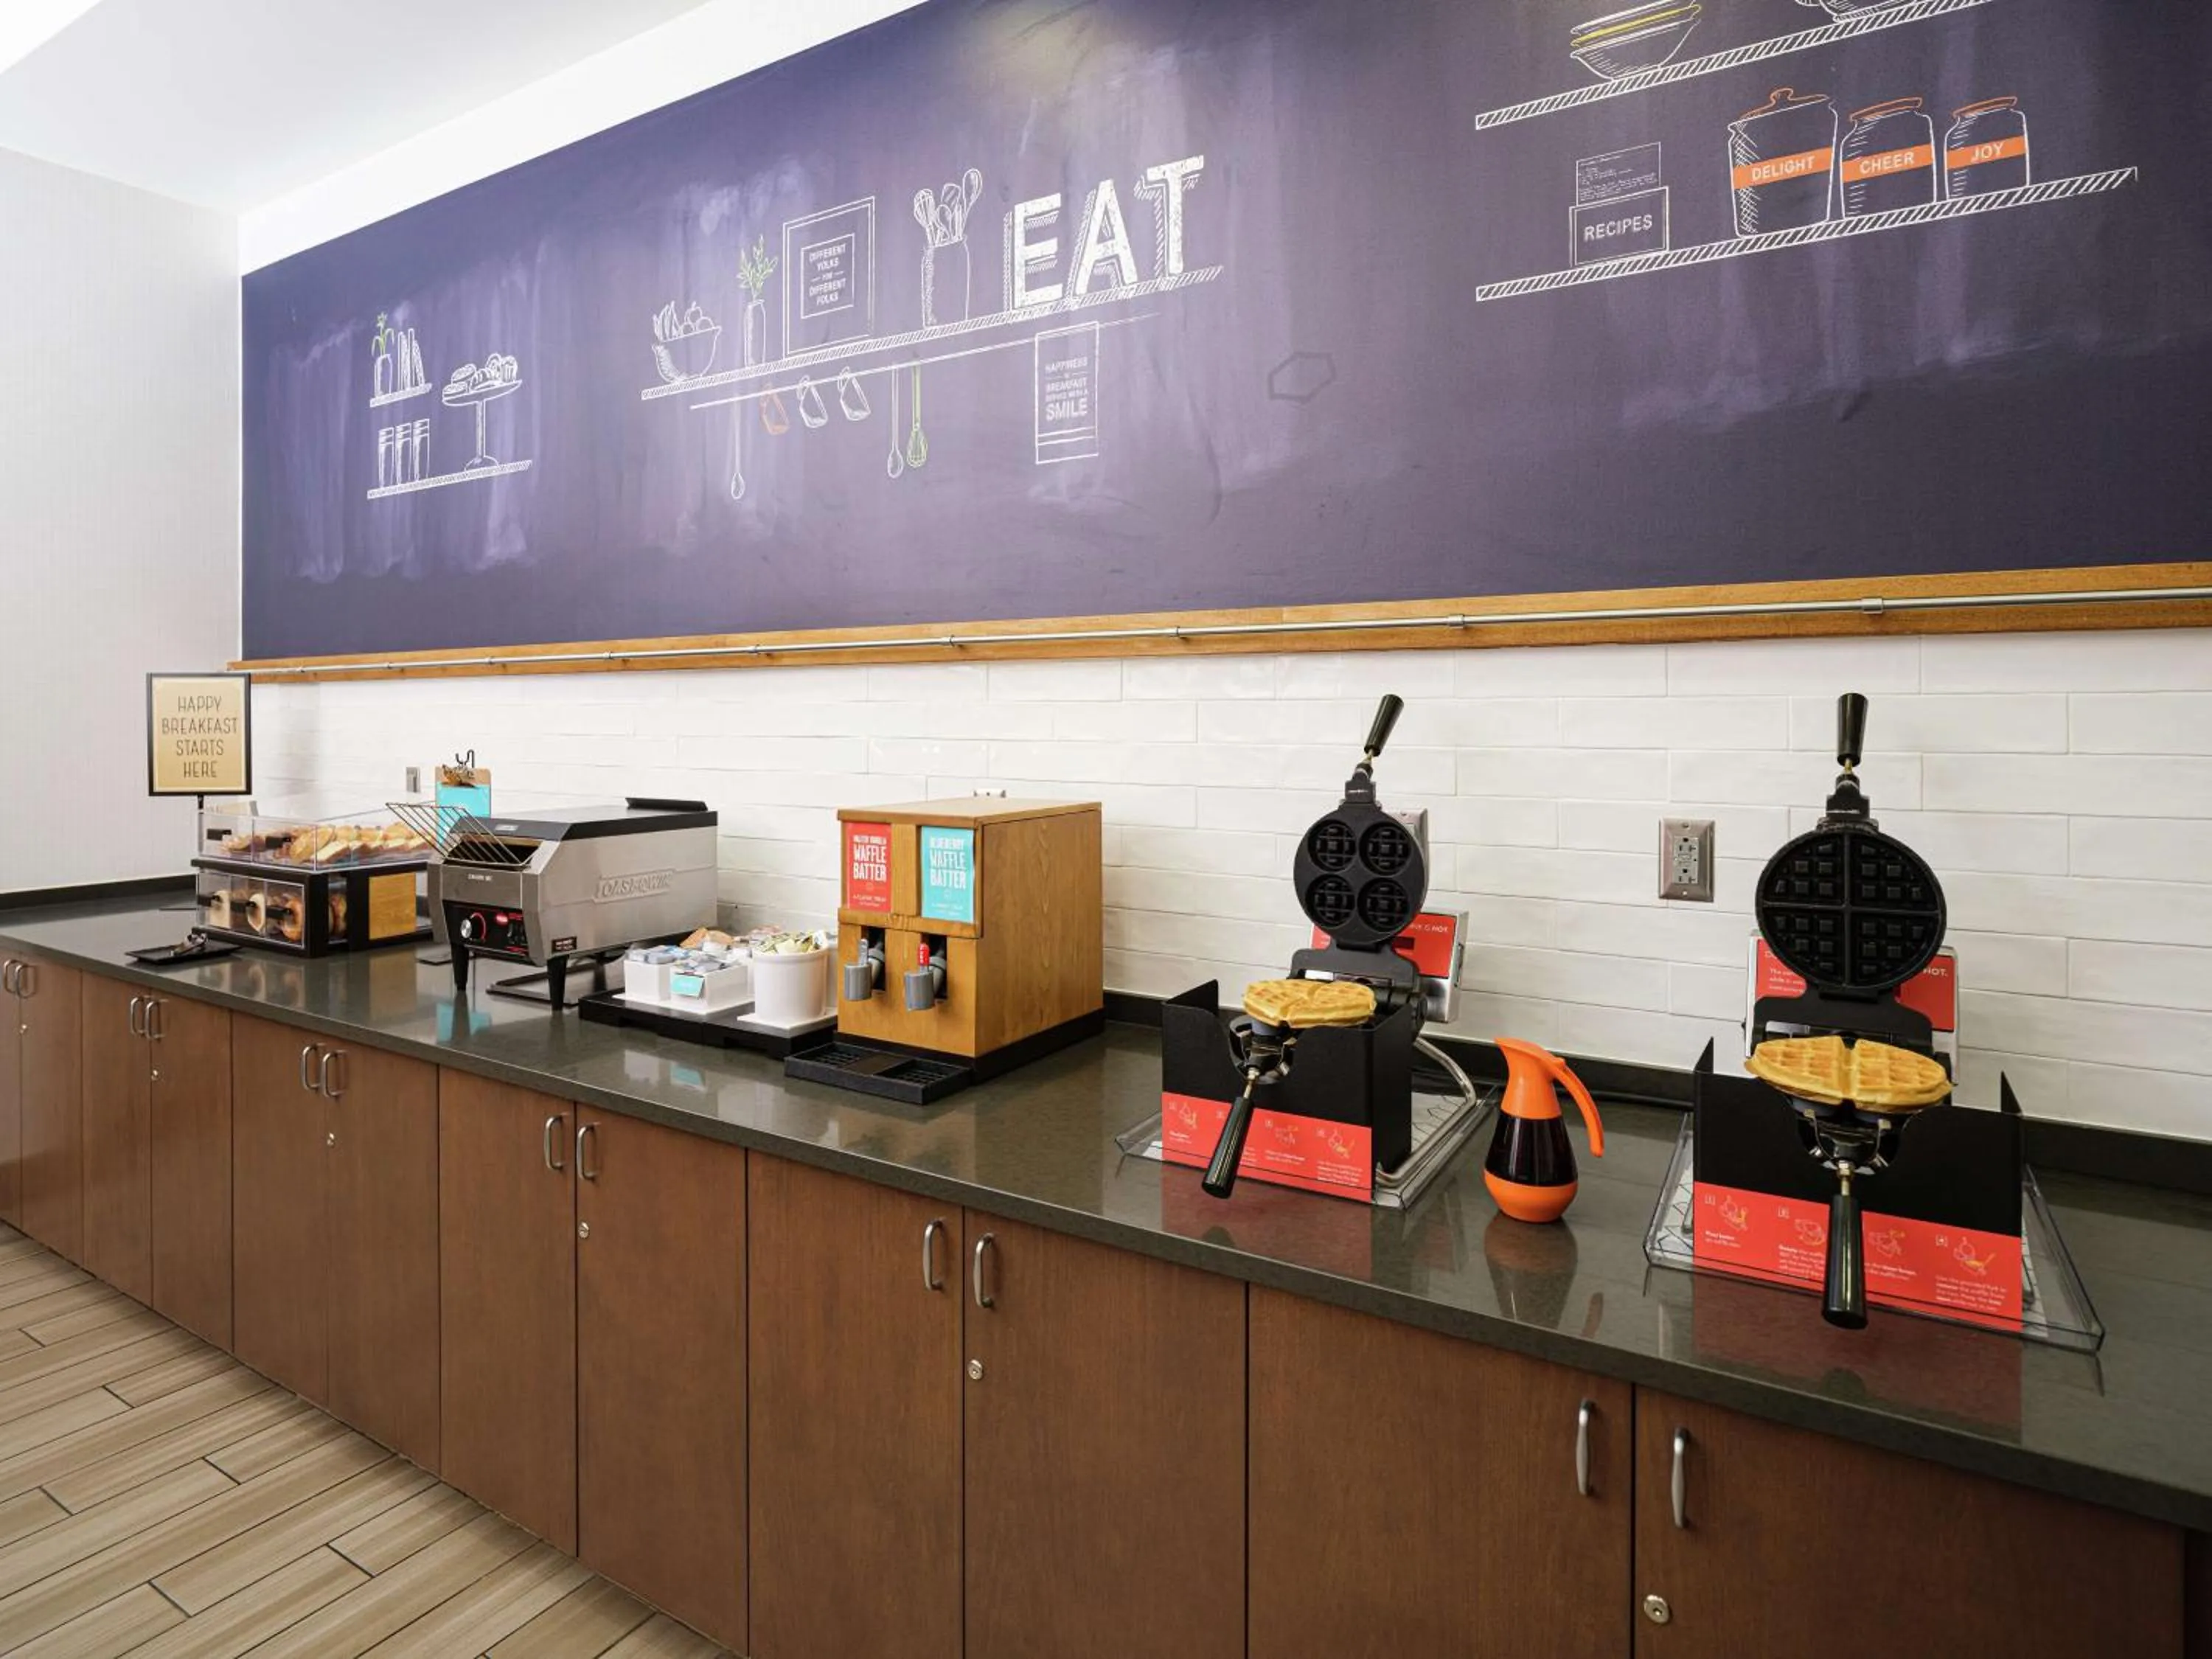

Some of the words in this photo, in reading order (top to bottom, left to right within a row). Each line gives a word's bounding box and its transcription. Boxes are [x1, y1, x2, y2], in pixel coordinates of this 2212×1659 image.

[1970, 142, 2006, 163] JOY
[1751, 156, 1815, 181] DELIGHT
[1860, 152, 1915, 175] CHEER
[1004, 155, 1204, 310] EAT
[1584, 214, 1652, 242] RECIPES
[809, 243, 846, 263] DIFFERENT
[809, 277, 846, 296] DIFFERENT
[1046, 397, 1088, 422] SMILE
[178, 695, 221, 713] HAPPY
[161, 717, 238, 735] BREAKFAST
[176, 739, 224, 757] STARTS
[184, 760, 218, 779] HERE
[853, 844, 886, 863] WAFFLE
[930, 849, 965, 869] WAFFLE
[853, 861, 886, 883] BATTER
[930, 868, 966, 889] BATTER
